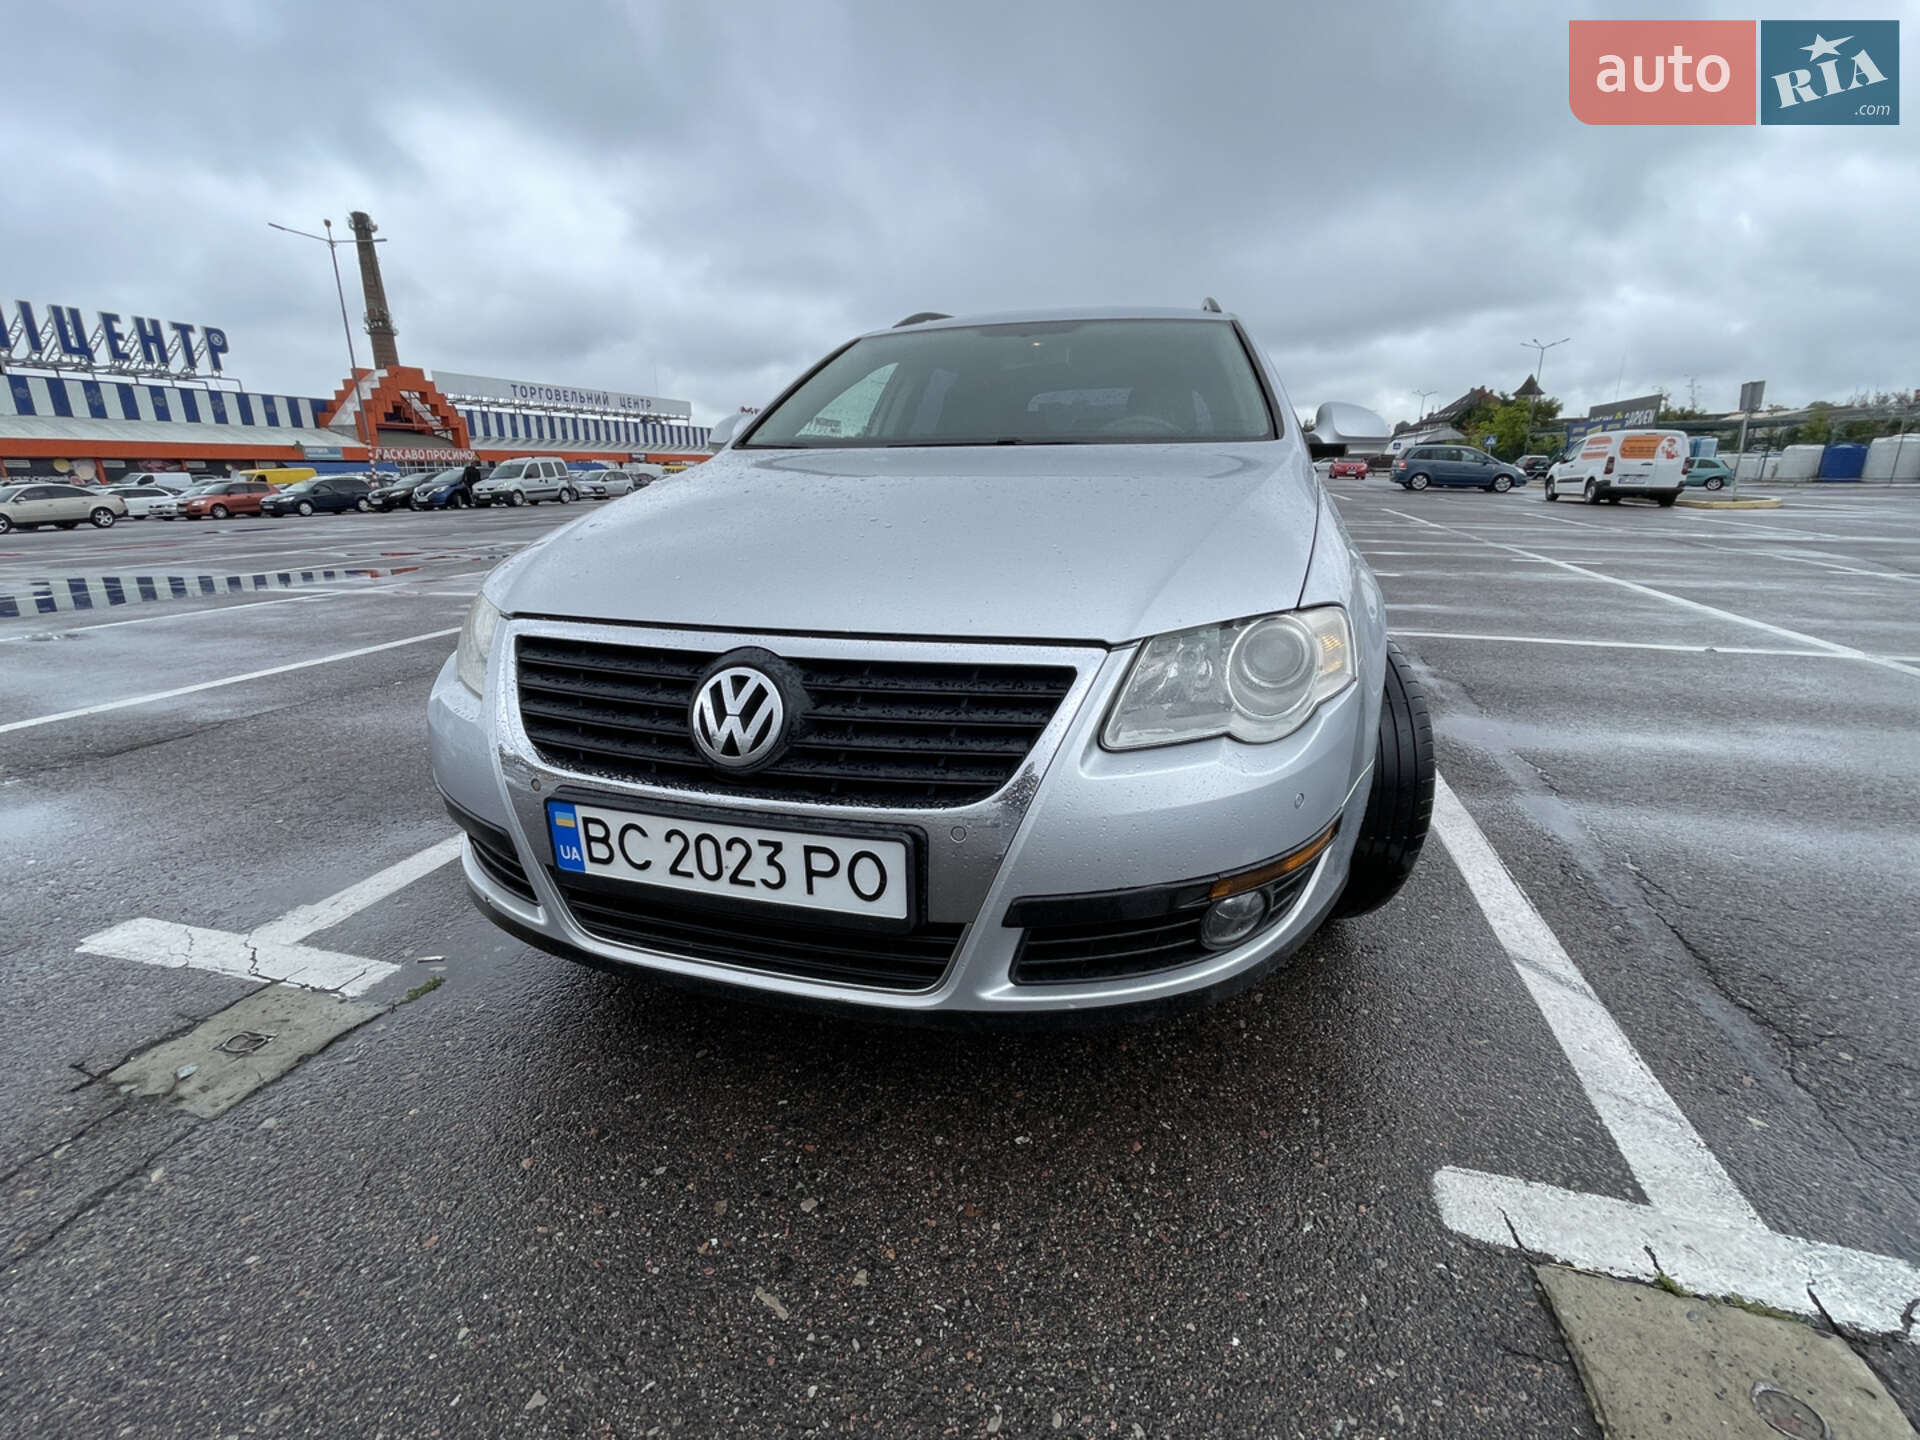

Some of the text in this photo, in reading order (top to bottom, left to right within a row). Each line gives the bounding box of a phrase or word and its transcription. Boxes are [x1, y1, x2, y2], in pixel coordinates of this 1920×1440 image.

[510, 384, 652, 410] ТОРГОВЕЛЬНИЙ ЦЕНТР
[375, 448, 425, 461] ЛАСКАВО
[560, 844, 581, 861] UA
[582, 816, 888, 902] BC 2023 PO
